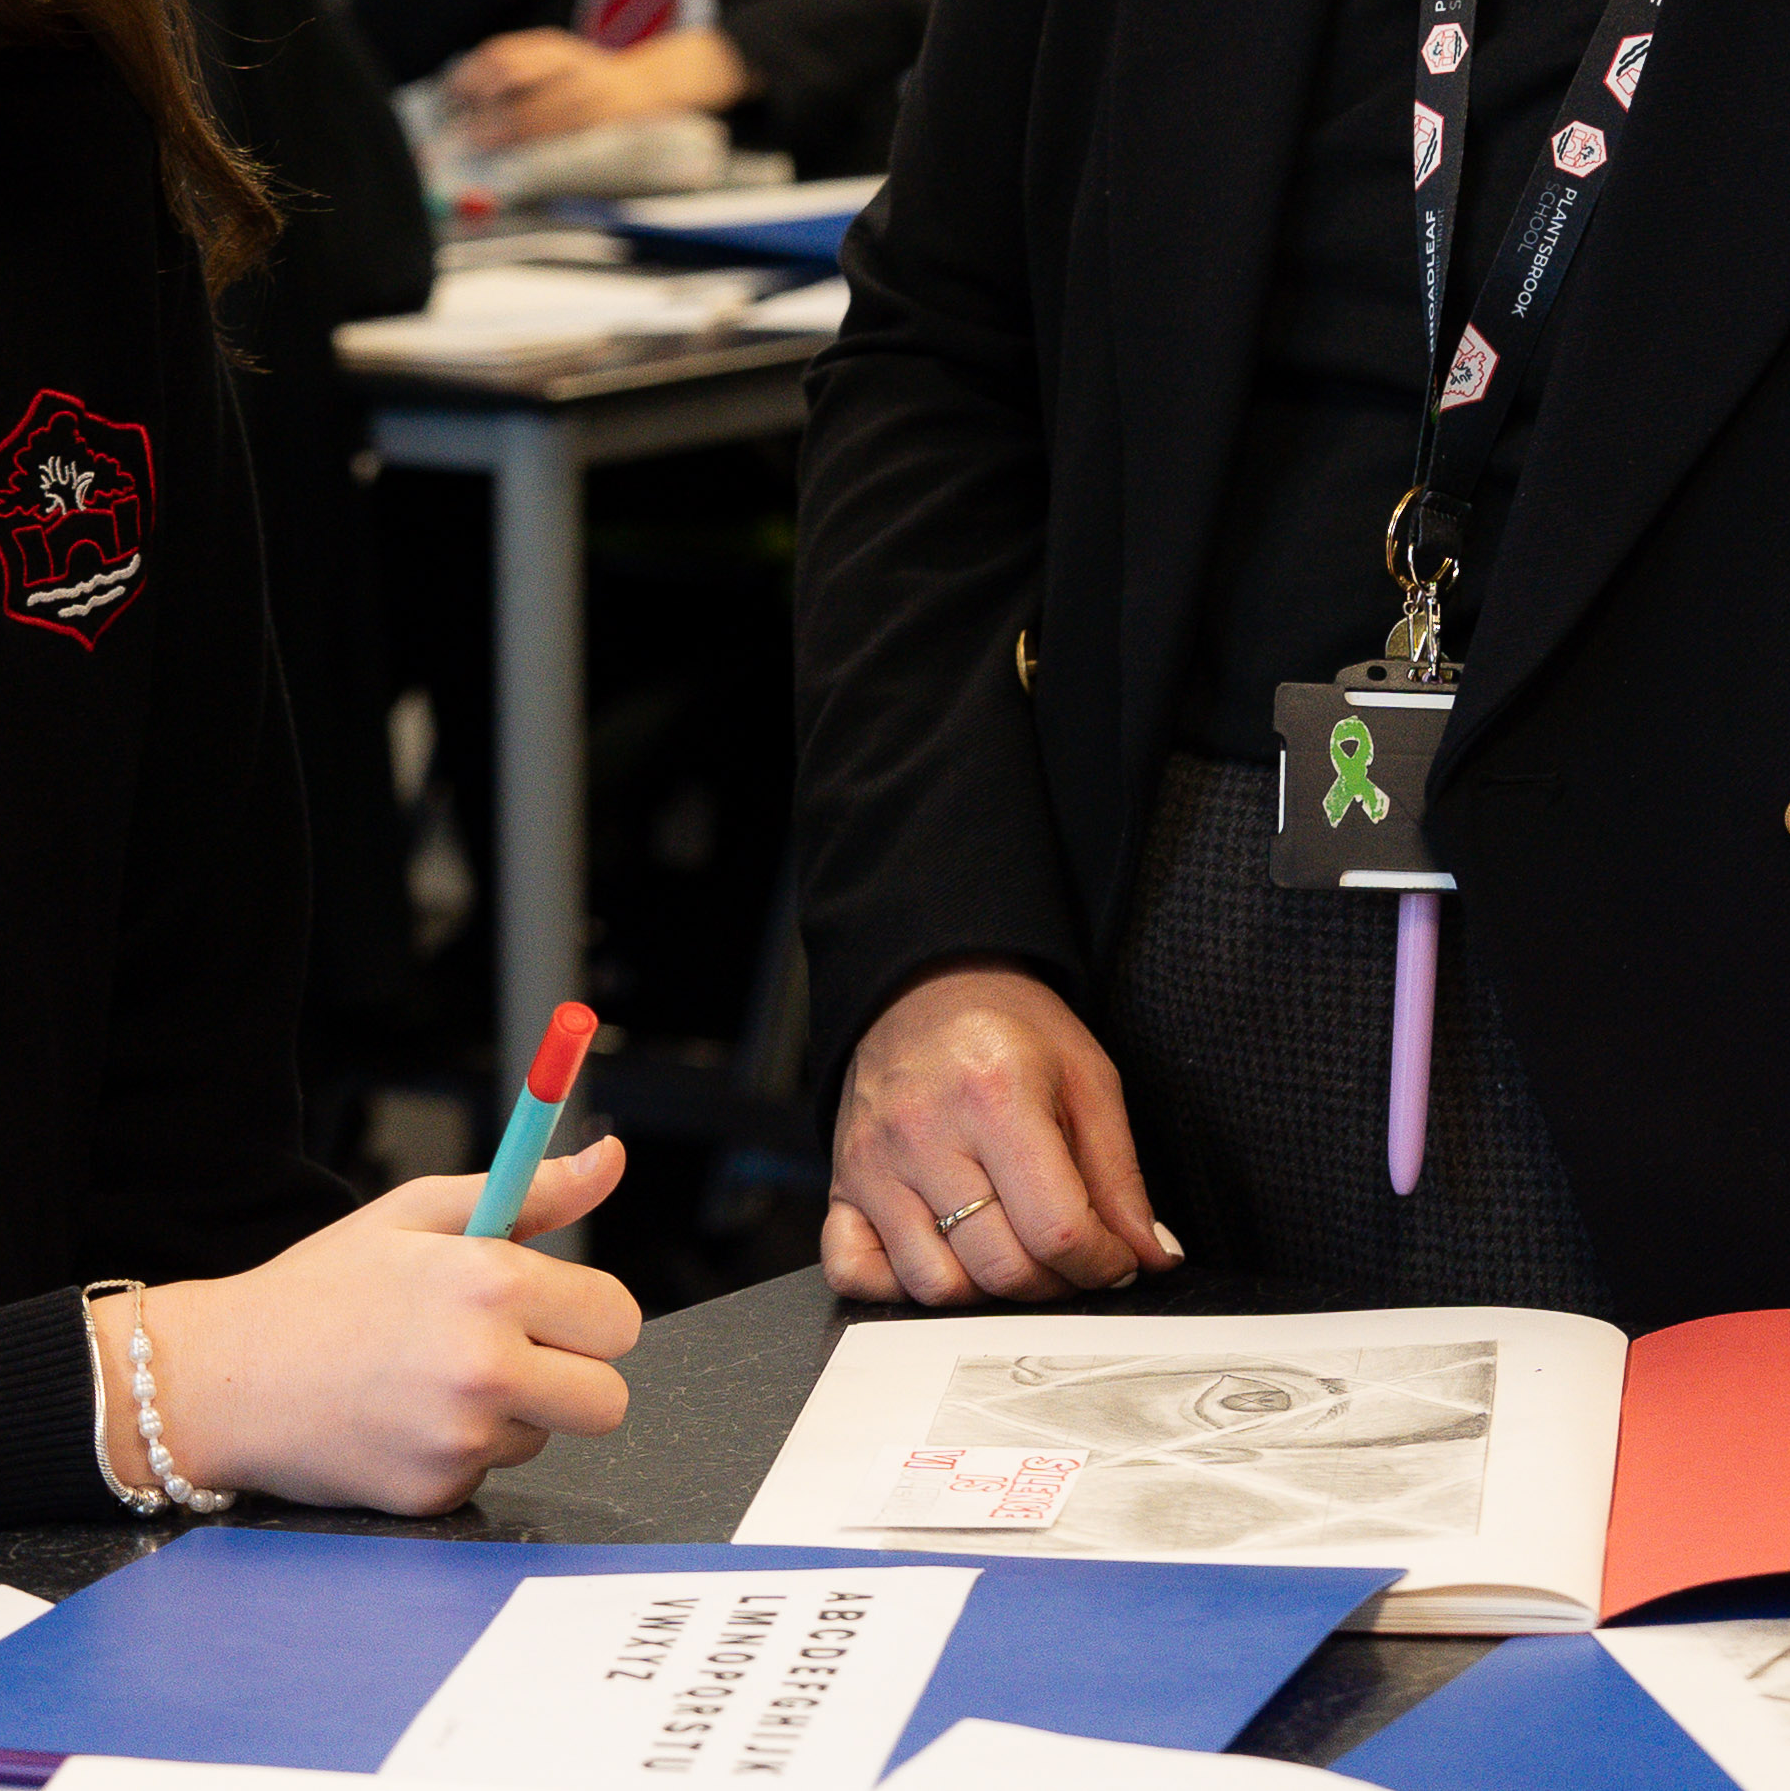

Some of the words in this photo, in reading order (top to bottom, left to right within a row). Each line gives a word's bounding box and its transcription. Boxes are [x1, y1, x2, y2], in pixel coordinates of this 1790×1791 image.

[1517, 181, 1558, 253] SCHOOL
[1511, 187, 1578, 319] PLANTSBROOK
[949, 1473, 1008, 1492] IS
[989, 1456, 1081, 1520] SILENCE
